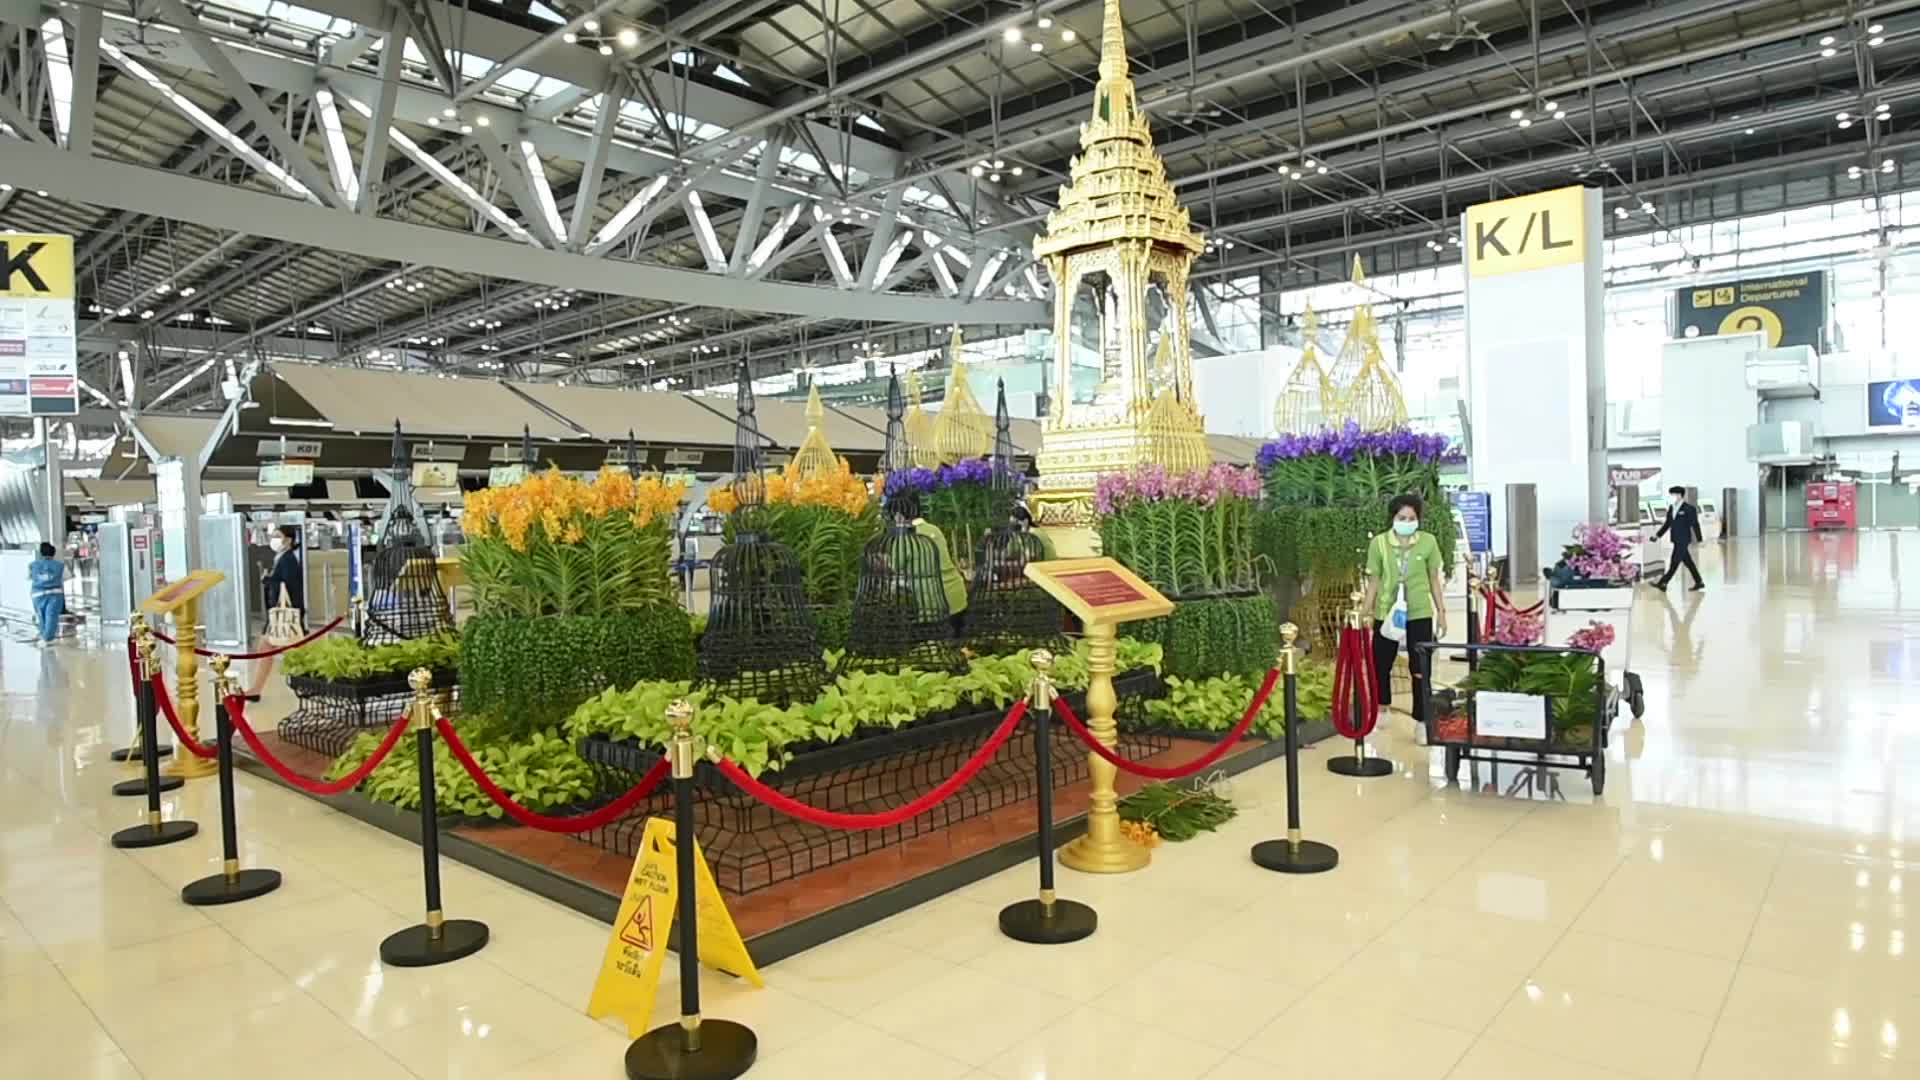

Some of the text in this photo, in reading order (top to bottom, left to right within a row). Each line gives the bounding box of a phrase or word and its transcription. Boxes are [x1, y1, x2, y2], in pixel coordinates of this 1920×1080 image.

[1475, 209, 1574, 261] K/L
[0, 241, 51, 292] K
[1740, 277, 1809, 292] International
[1740, 289, 1801, 303] Departures
